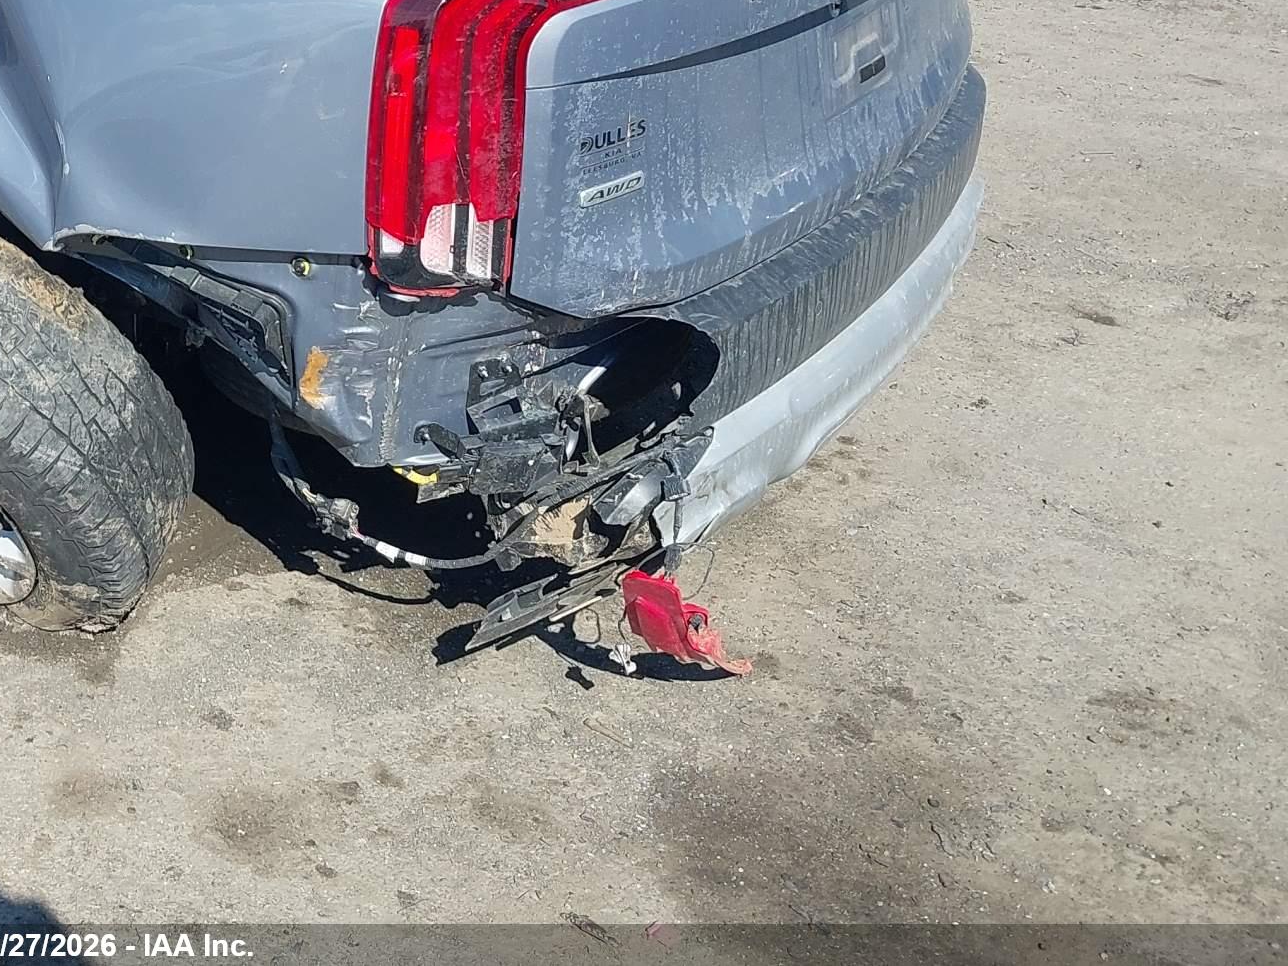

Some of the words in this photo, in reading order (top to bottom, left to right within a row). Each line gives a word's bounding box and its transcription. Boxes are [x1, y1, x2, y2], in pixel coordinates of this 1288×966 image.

[580, 119, 646, 154] DULLES
[604, 148, 622, 159] KIA
[587, 176, 642, 202] AWD
